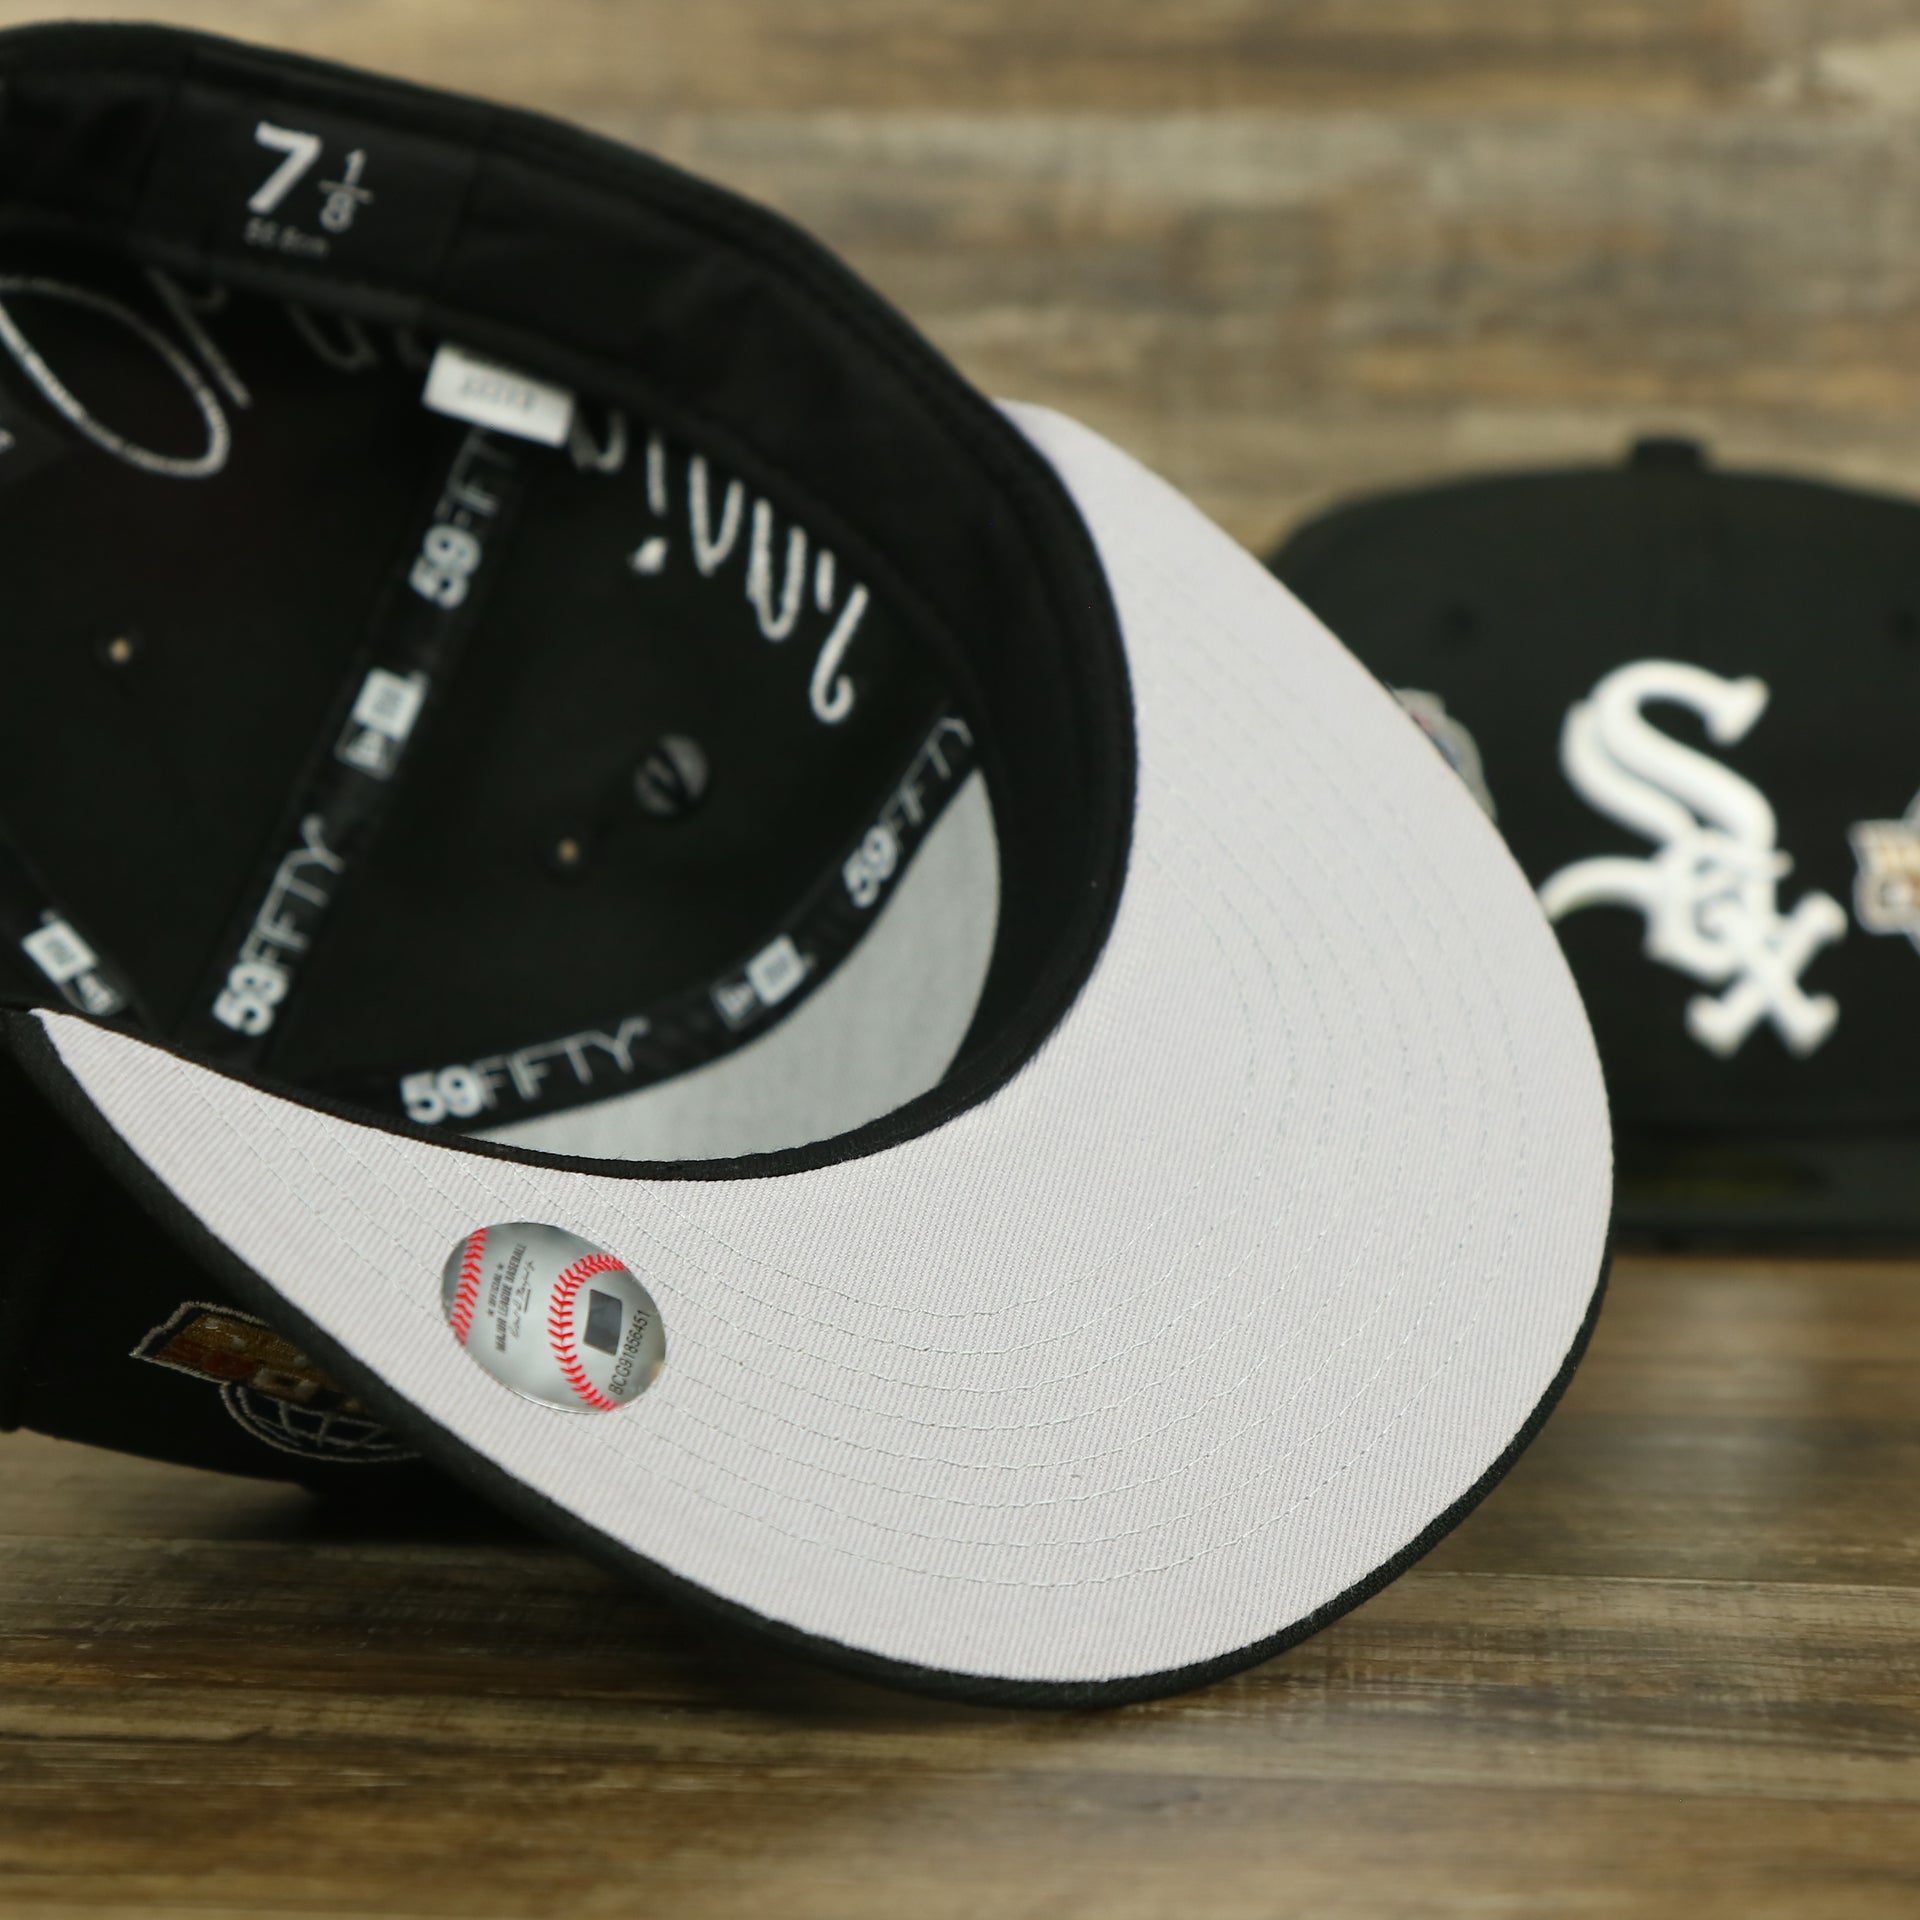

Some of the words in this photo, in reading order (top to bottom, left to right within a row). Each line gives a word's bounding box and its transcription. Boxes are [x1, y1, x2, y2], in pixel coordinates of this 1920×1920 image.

[247, 120, 322, 215] 7
[212, 814, 346, 1037] 59FIFTY
[400, 1016, 651, 1124] 59FIFTY
[497, 1283, 512, 1317] LEAGUE
[504, 1243, 527, 1283] BASEBALL
[496, 1318, 507, 1353] MAJOR
[608, 1310, 650, 1395] BCG91856451
